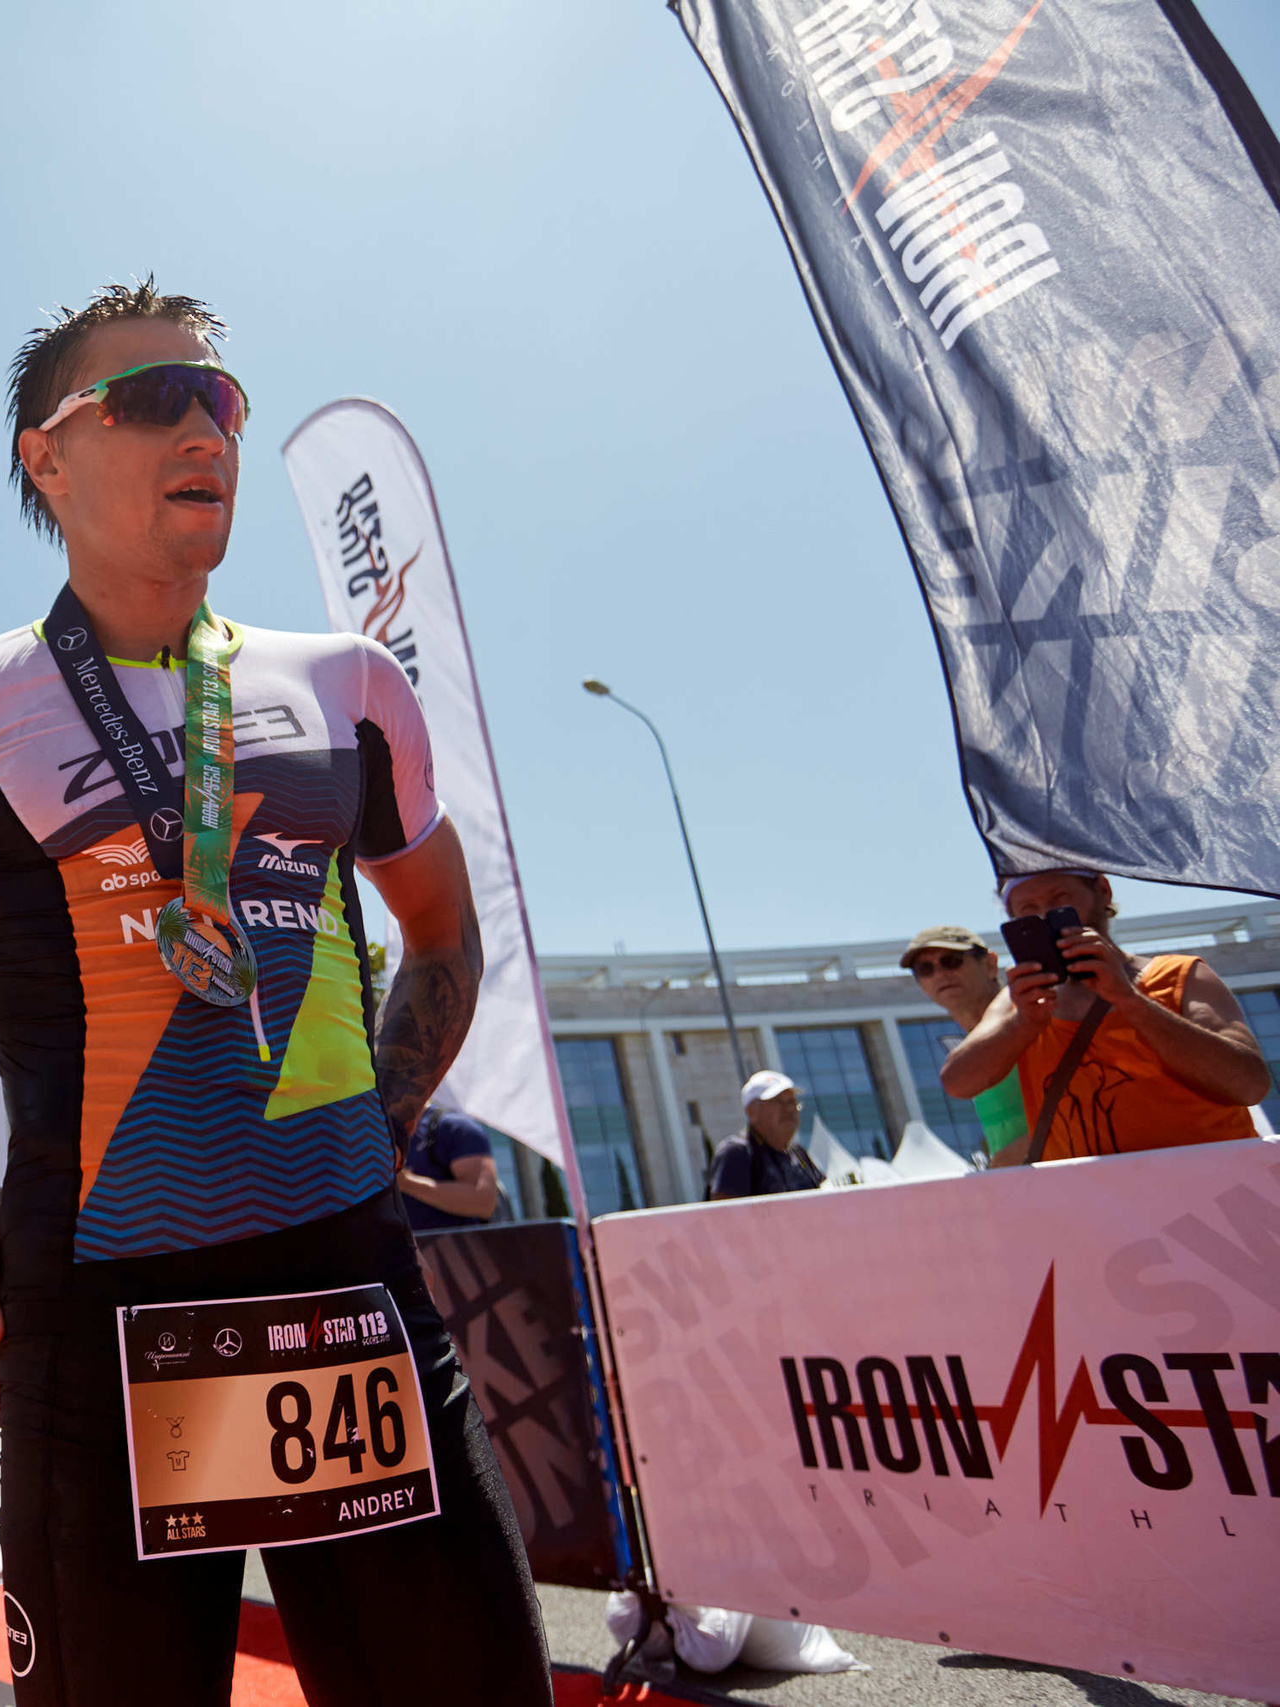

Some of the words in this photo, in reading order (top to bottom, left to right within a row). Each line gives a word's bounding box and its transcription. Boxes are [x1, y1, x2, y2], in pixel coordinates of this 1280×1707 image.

[203, 680, 219, 698] 113
[72, 656, 159, 796] Mercedes-Benz
[267, 1322, 307, 1351] IRON
[323, 1316, 357, 1345] STAR
[358, 1310, 388, 1338] 113
[266, 1366, 407, 1485] 846
[779, 1354, 994, 1480] IRON
[338, 1486, 416, 1522] ANDREY
[166, 1529, 180, 1541] ALL
[181, 1524, 207, 1539] STARS
